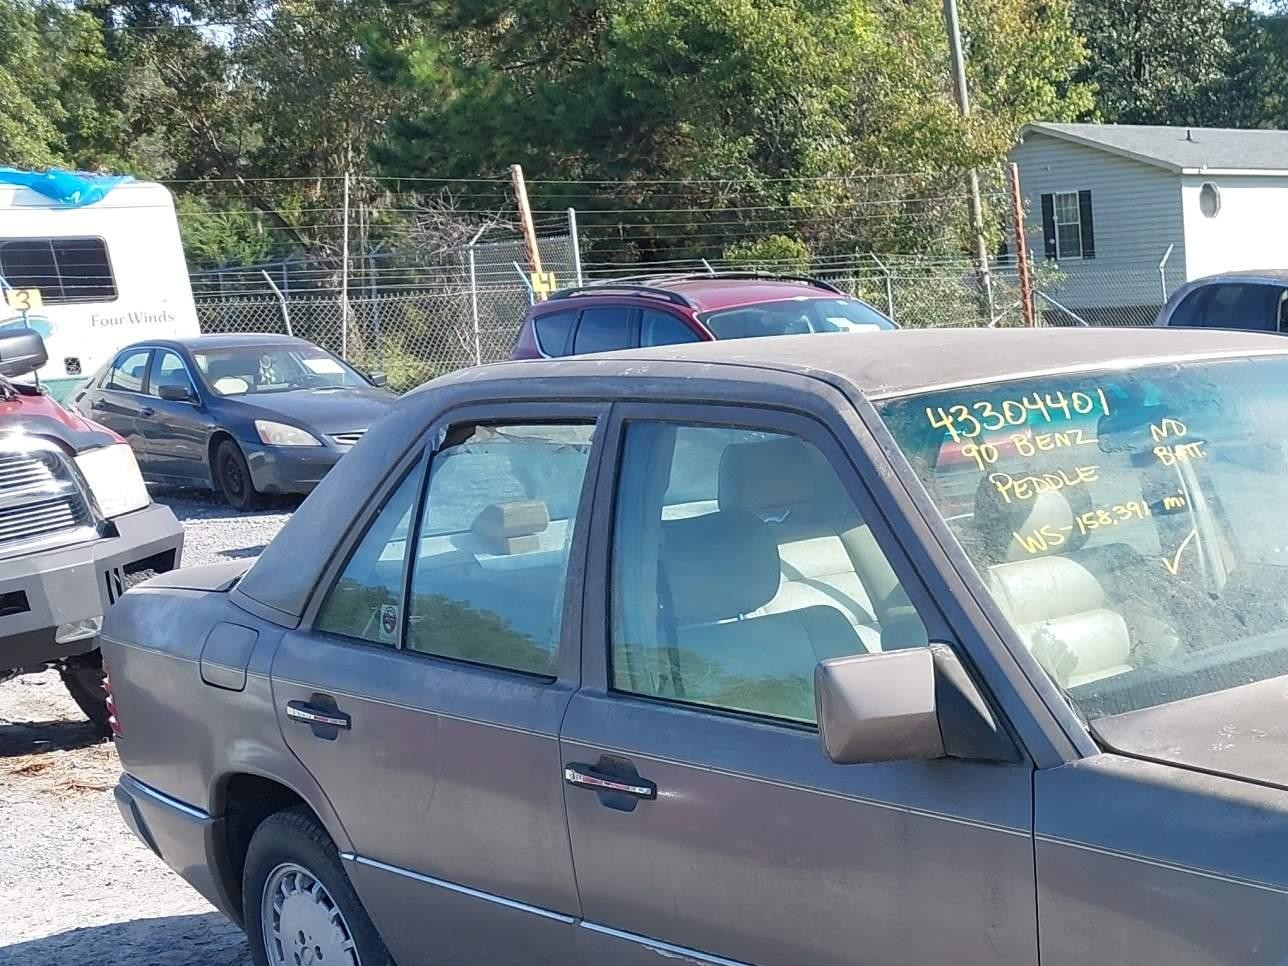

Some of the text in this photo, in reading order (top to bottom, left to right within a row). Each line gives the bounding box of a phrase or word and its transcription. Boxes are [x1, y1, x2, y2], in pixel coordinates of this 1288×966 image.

[15, 290, 31, 311] 3
[91, 310, 175, 328] Four Winds
[926, 388, 1110, 444] 43304401
[961, 429, 1100, 471] 90 BENZ
[988, 466, 1100, 505] PEDDLE
